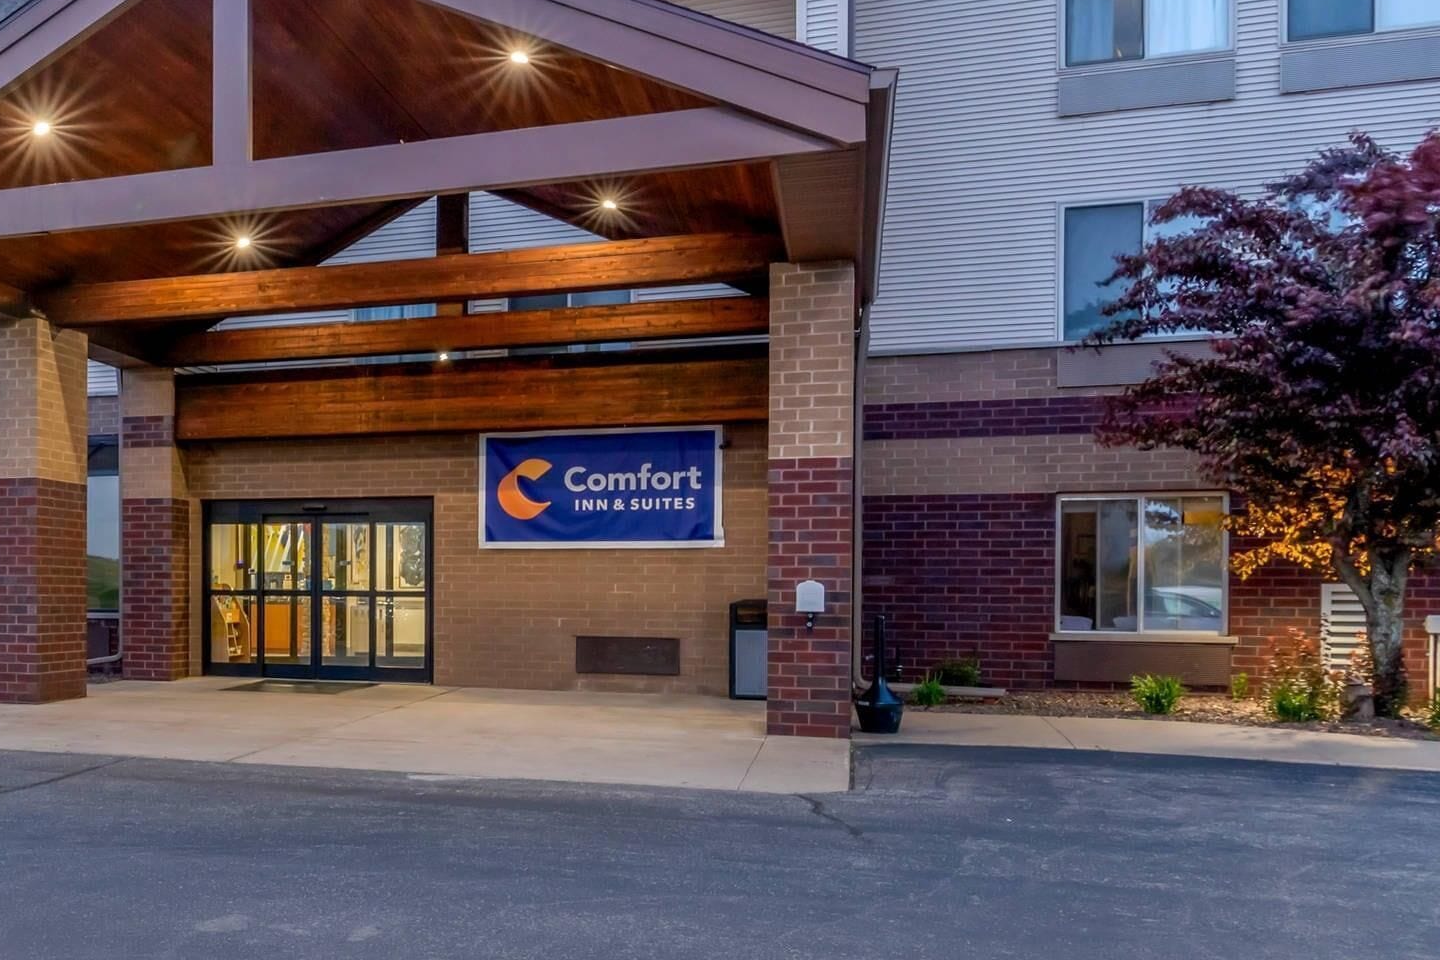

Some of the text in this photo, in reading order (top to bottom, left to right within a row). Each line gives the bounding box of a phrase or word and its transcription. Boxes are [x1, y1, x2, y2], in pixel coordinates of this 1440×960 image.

[564, 463, 702, 492] Comfort
[574, 497, 696, 511] INN & SUITES
